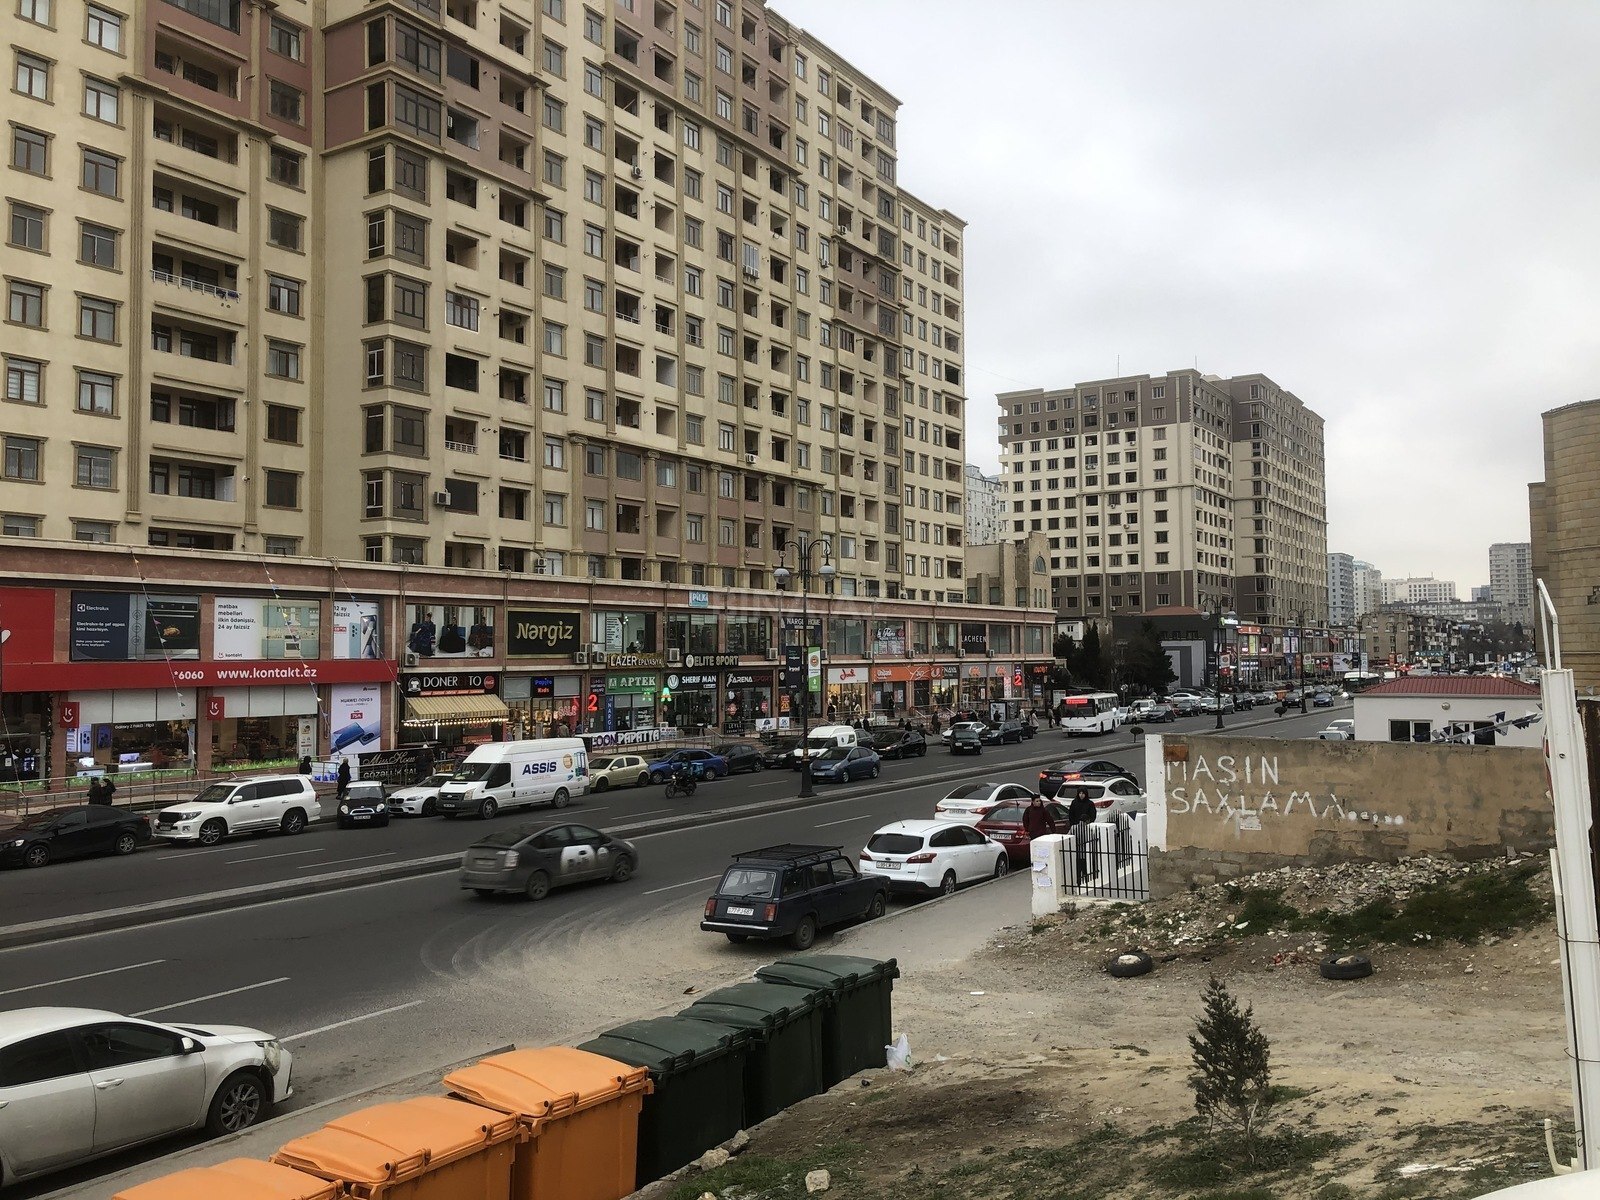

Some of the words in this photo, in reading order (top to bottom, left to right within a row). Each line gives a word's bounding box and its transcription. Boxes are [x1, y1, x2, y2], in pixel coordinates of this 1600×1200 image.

[516, 620, 574, 647] Nərgiz
[610, 655, 637, 666] LAZER
[694, 655, 715, 667] ELITE
[716, 655, 738, 666] SPORT
[217, 666, 317, 679] www.kontakt.az
[423, 676, 458, 688] DONER
[620, 676, 656, 687] APTEK
[702, 675, 717, 683] MAN
[587, 694, 598, 711] 2
[618, 729, 660, 744] PAPATYA
